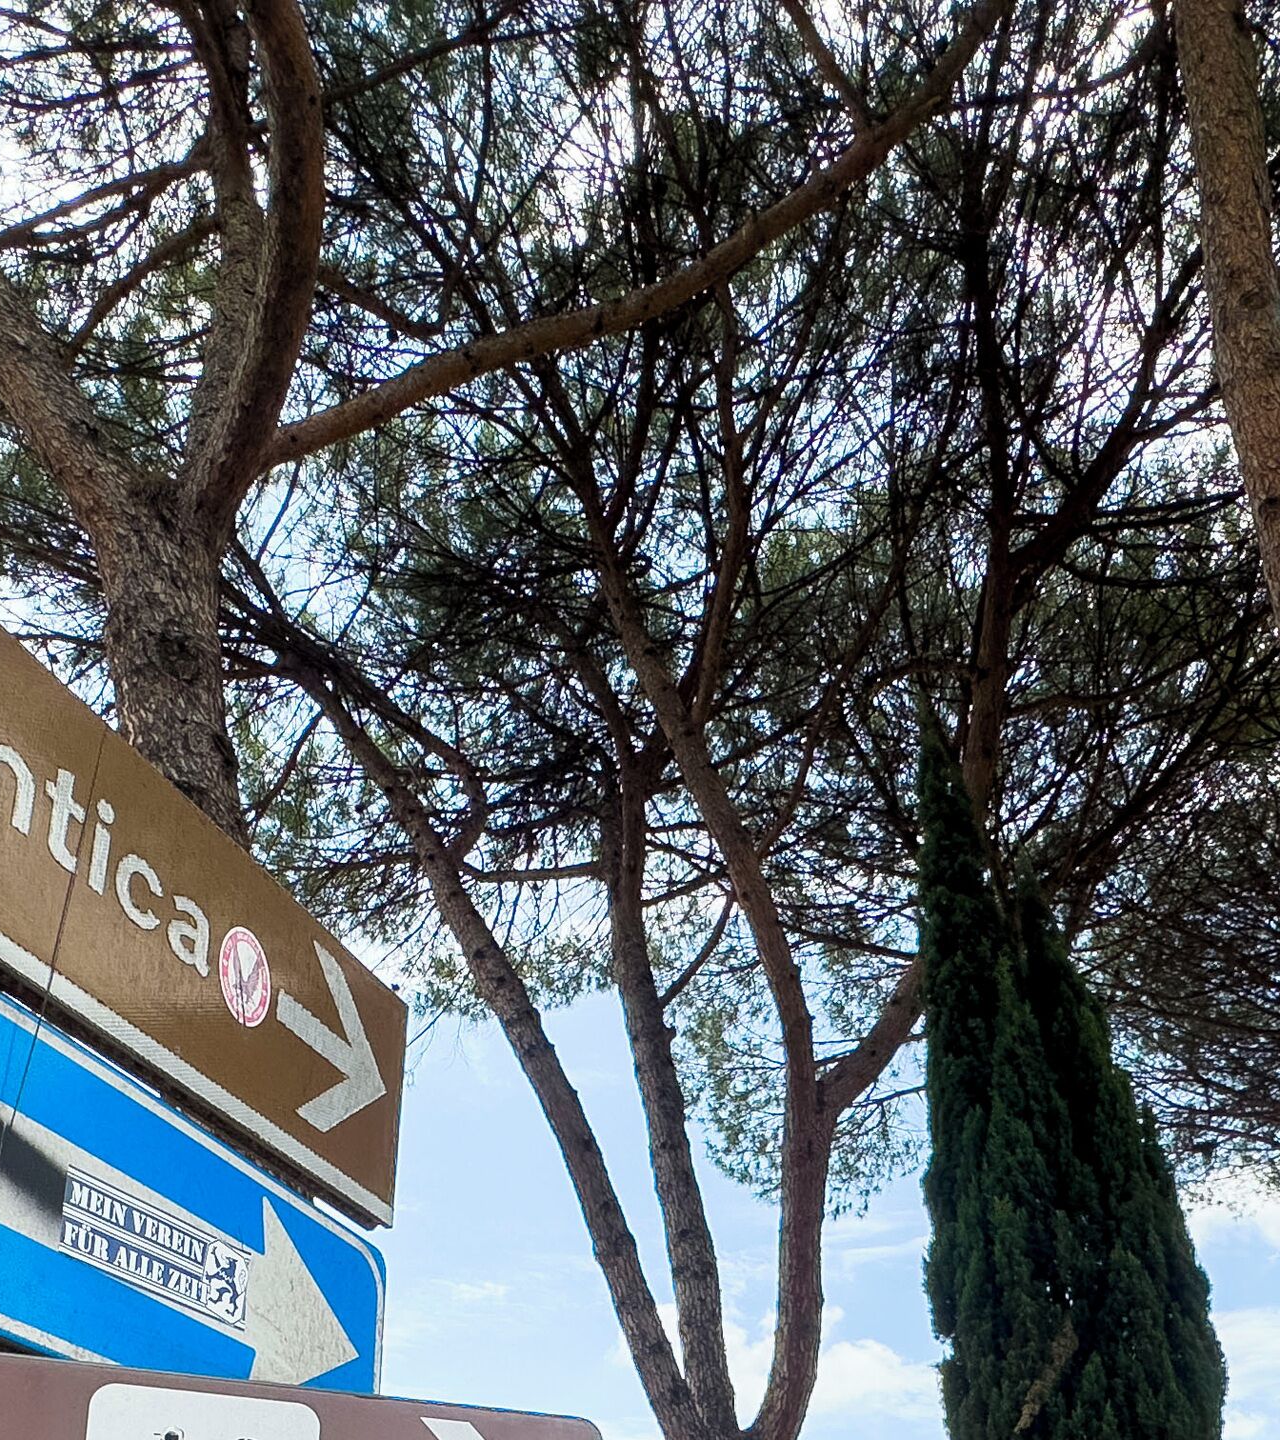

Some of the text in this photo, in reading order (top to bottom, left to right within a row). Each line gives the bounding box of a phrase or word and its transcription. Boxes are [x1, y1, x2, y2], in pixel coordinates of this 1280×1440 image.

[63, 1221, 211, 1304] FÜR ALLE ZEIT
[69, 1181, 206, 1264] MEIN VEREIN
